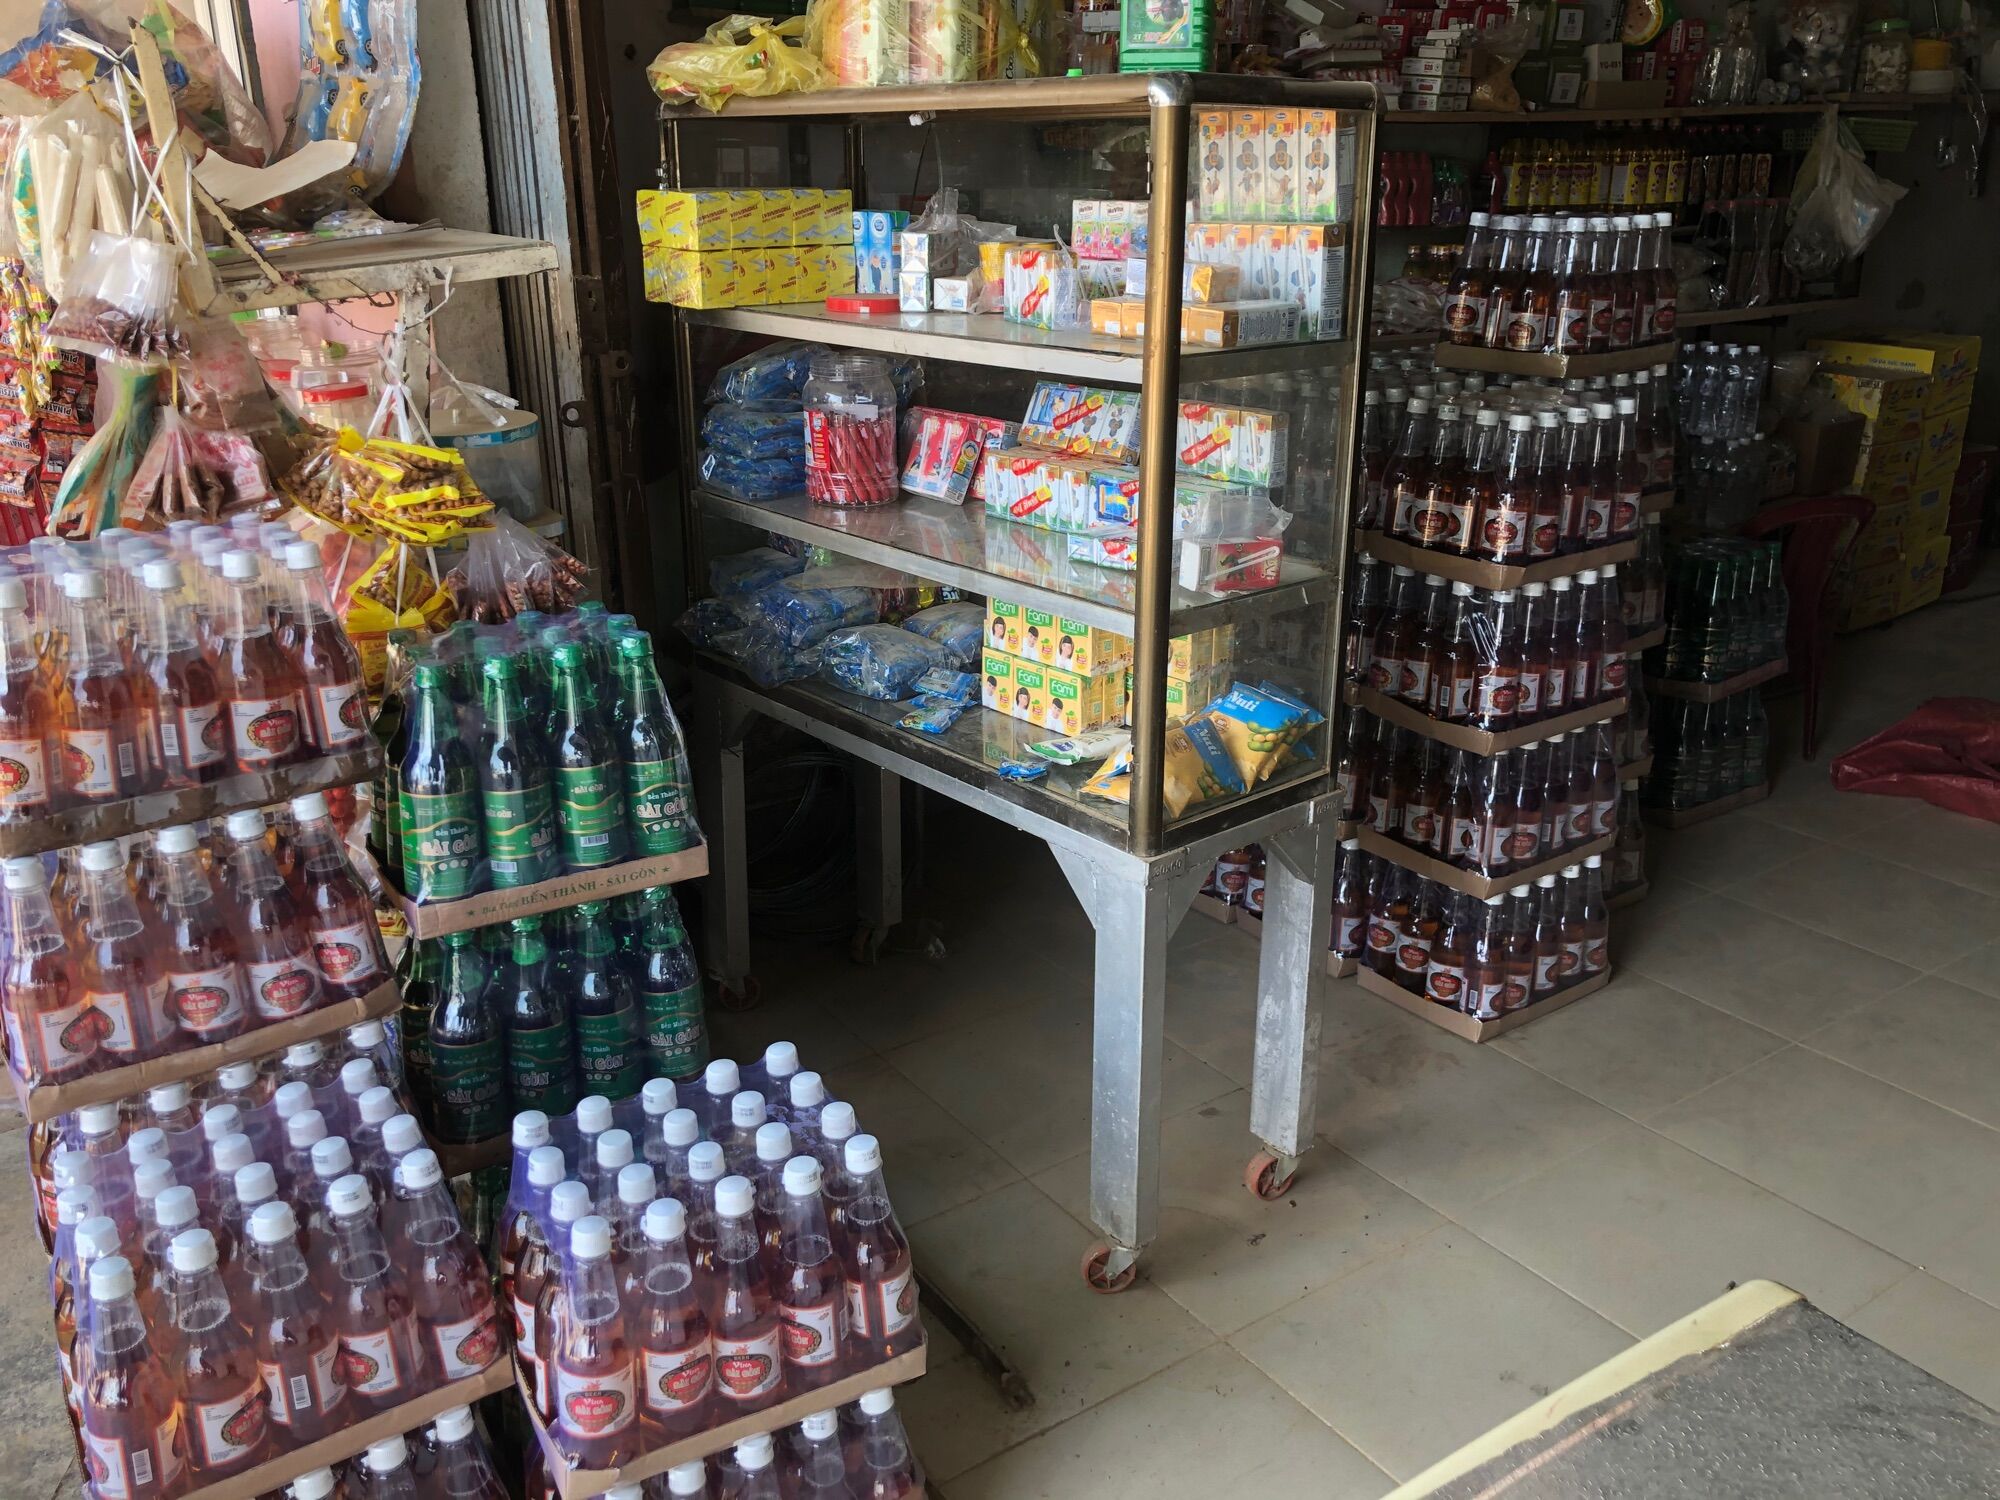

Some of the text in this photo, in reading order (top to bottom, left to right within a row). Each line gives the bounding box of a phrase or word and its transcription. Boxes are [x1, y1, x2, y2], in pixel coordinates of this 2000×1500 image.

[1230, 691, 1260, 712] Nuti
[636, 801, 662, 818] SÀI
[420, 838, 450, 857] SÀI
[630, 866, 657, 882] GÒN
